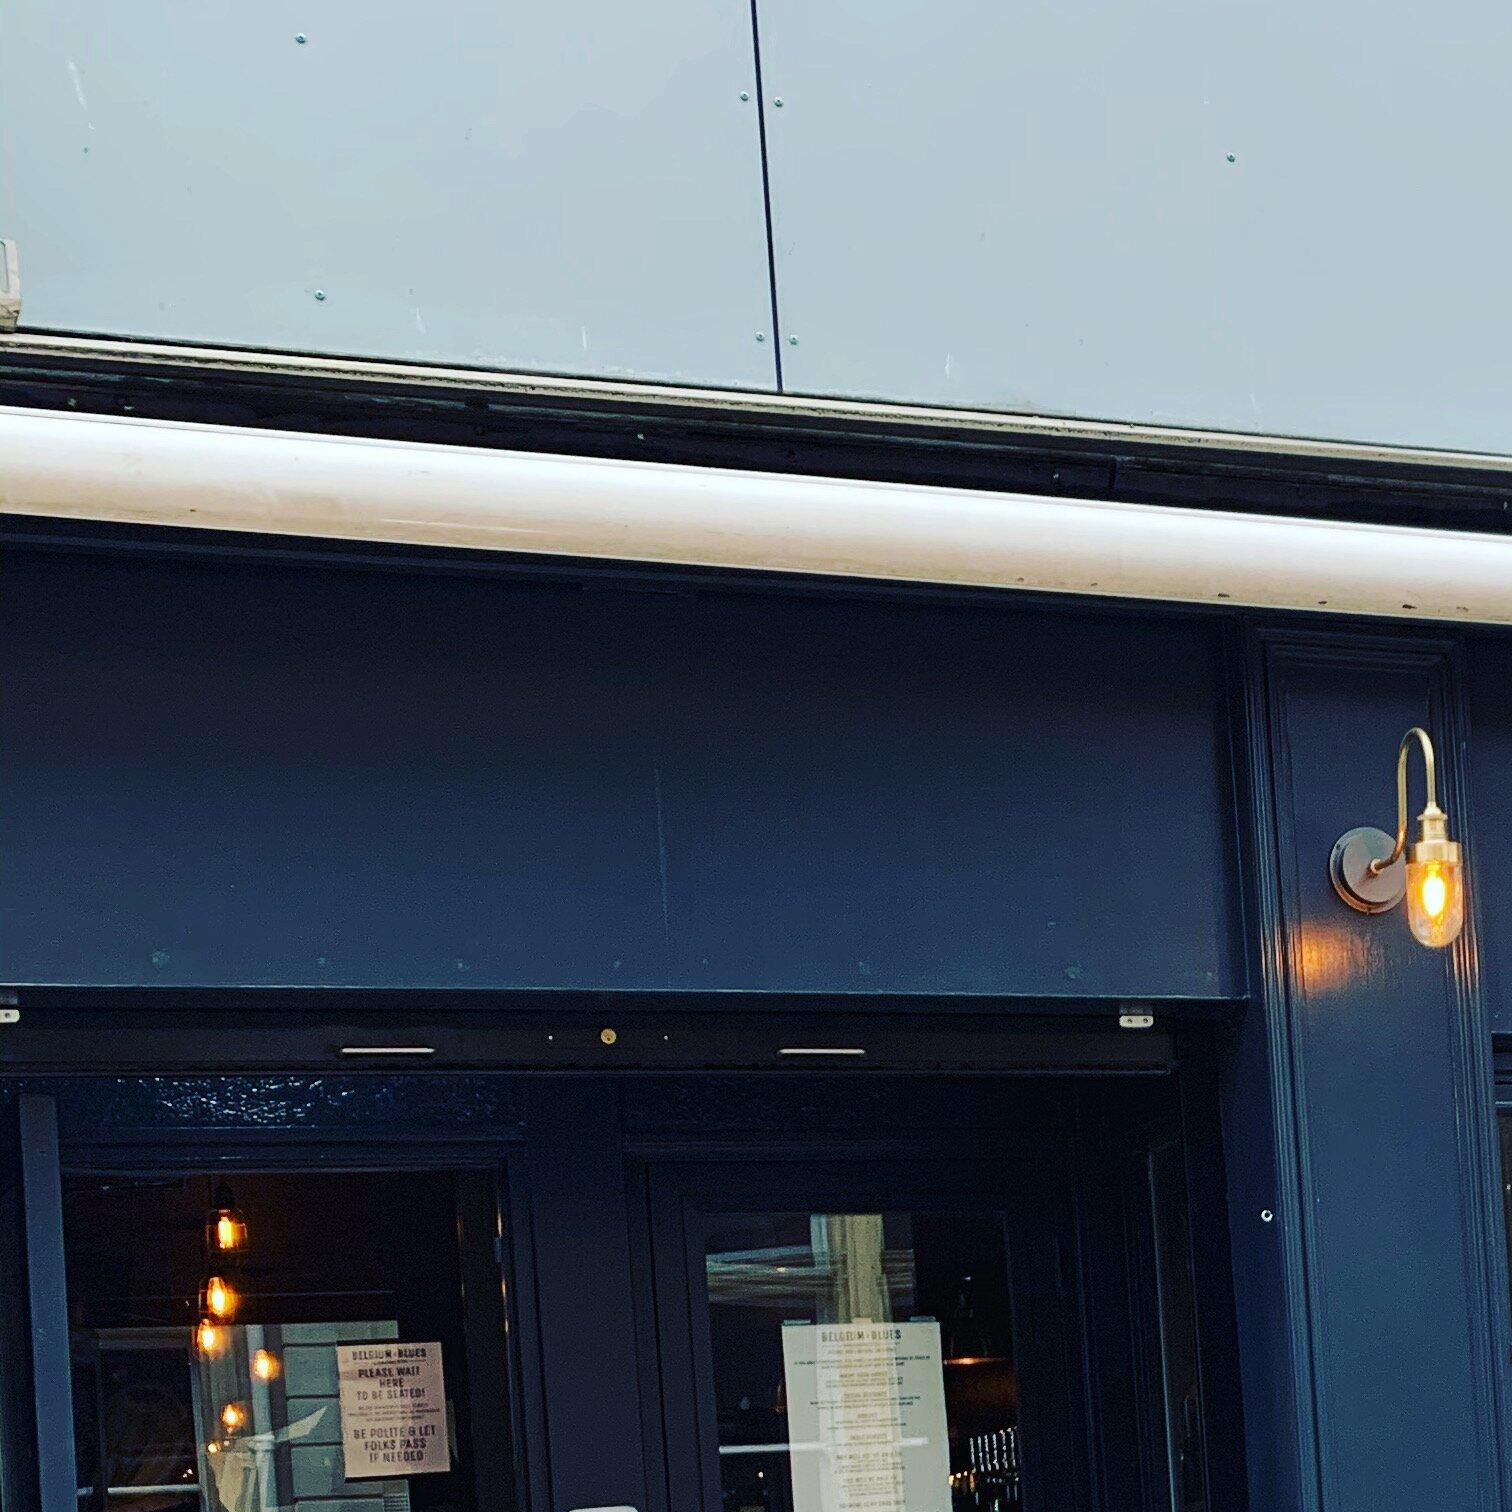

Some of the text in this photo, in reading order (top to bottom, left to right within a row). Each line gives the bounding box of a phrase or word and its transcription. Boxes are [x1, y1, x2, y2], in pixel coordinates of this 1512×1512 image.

[398, 1348, 426, 1358] BLUES
[358, 1366, 420, 1378] PLEASE WAIT
[379, 1378, 404, 1388] HERE
[357, 1390, 368, 1400] TO
[372, 1390, 382, 1399] BE
[354, 1429, 366, 1440] BE
[370, 1428, 405, 1439] POLITE
[419, 1425, 436, 1436] LET
[364, 1438, 427, 1451] FOLKS PASS
[383, 1451, 424, 1462] NEEDED
